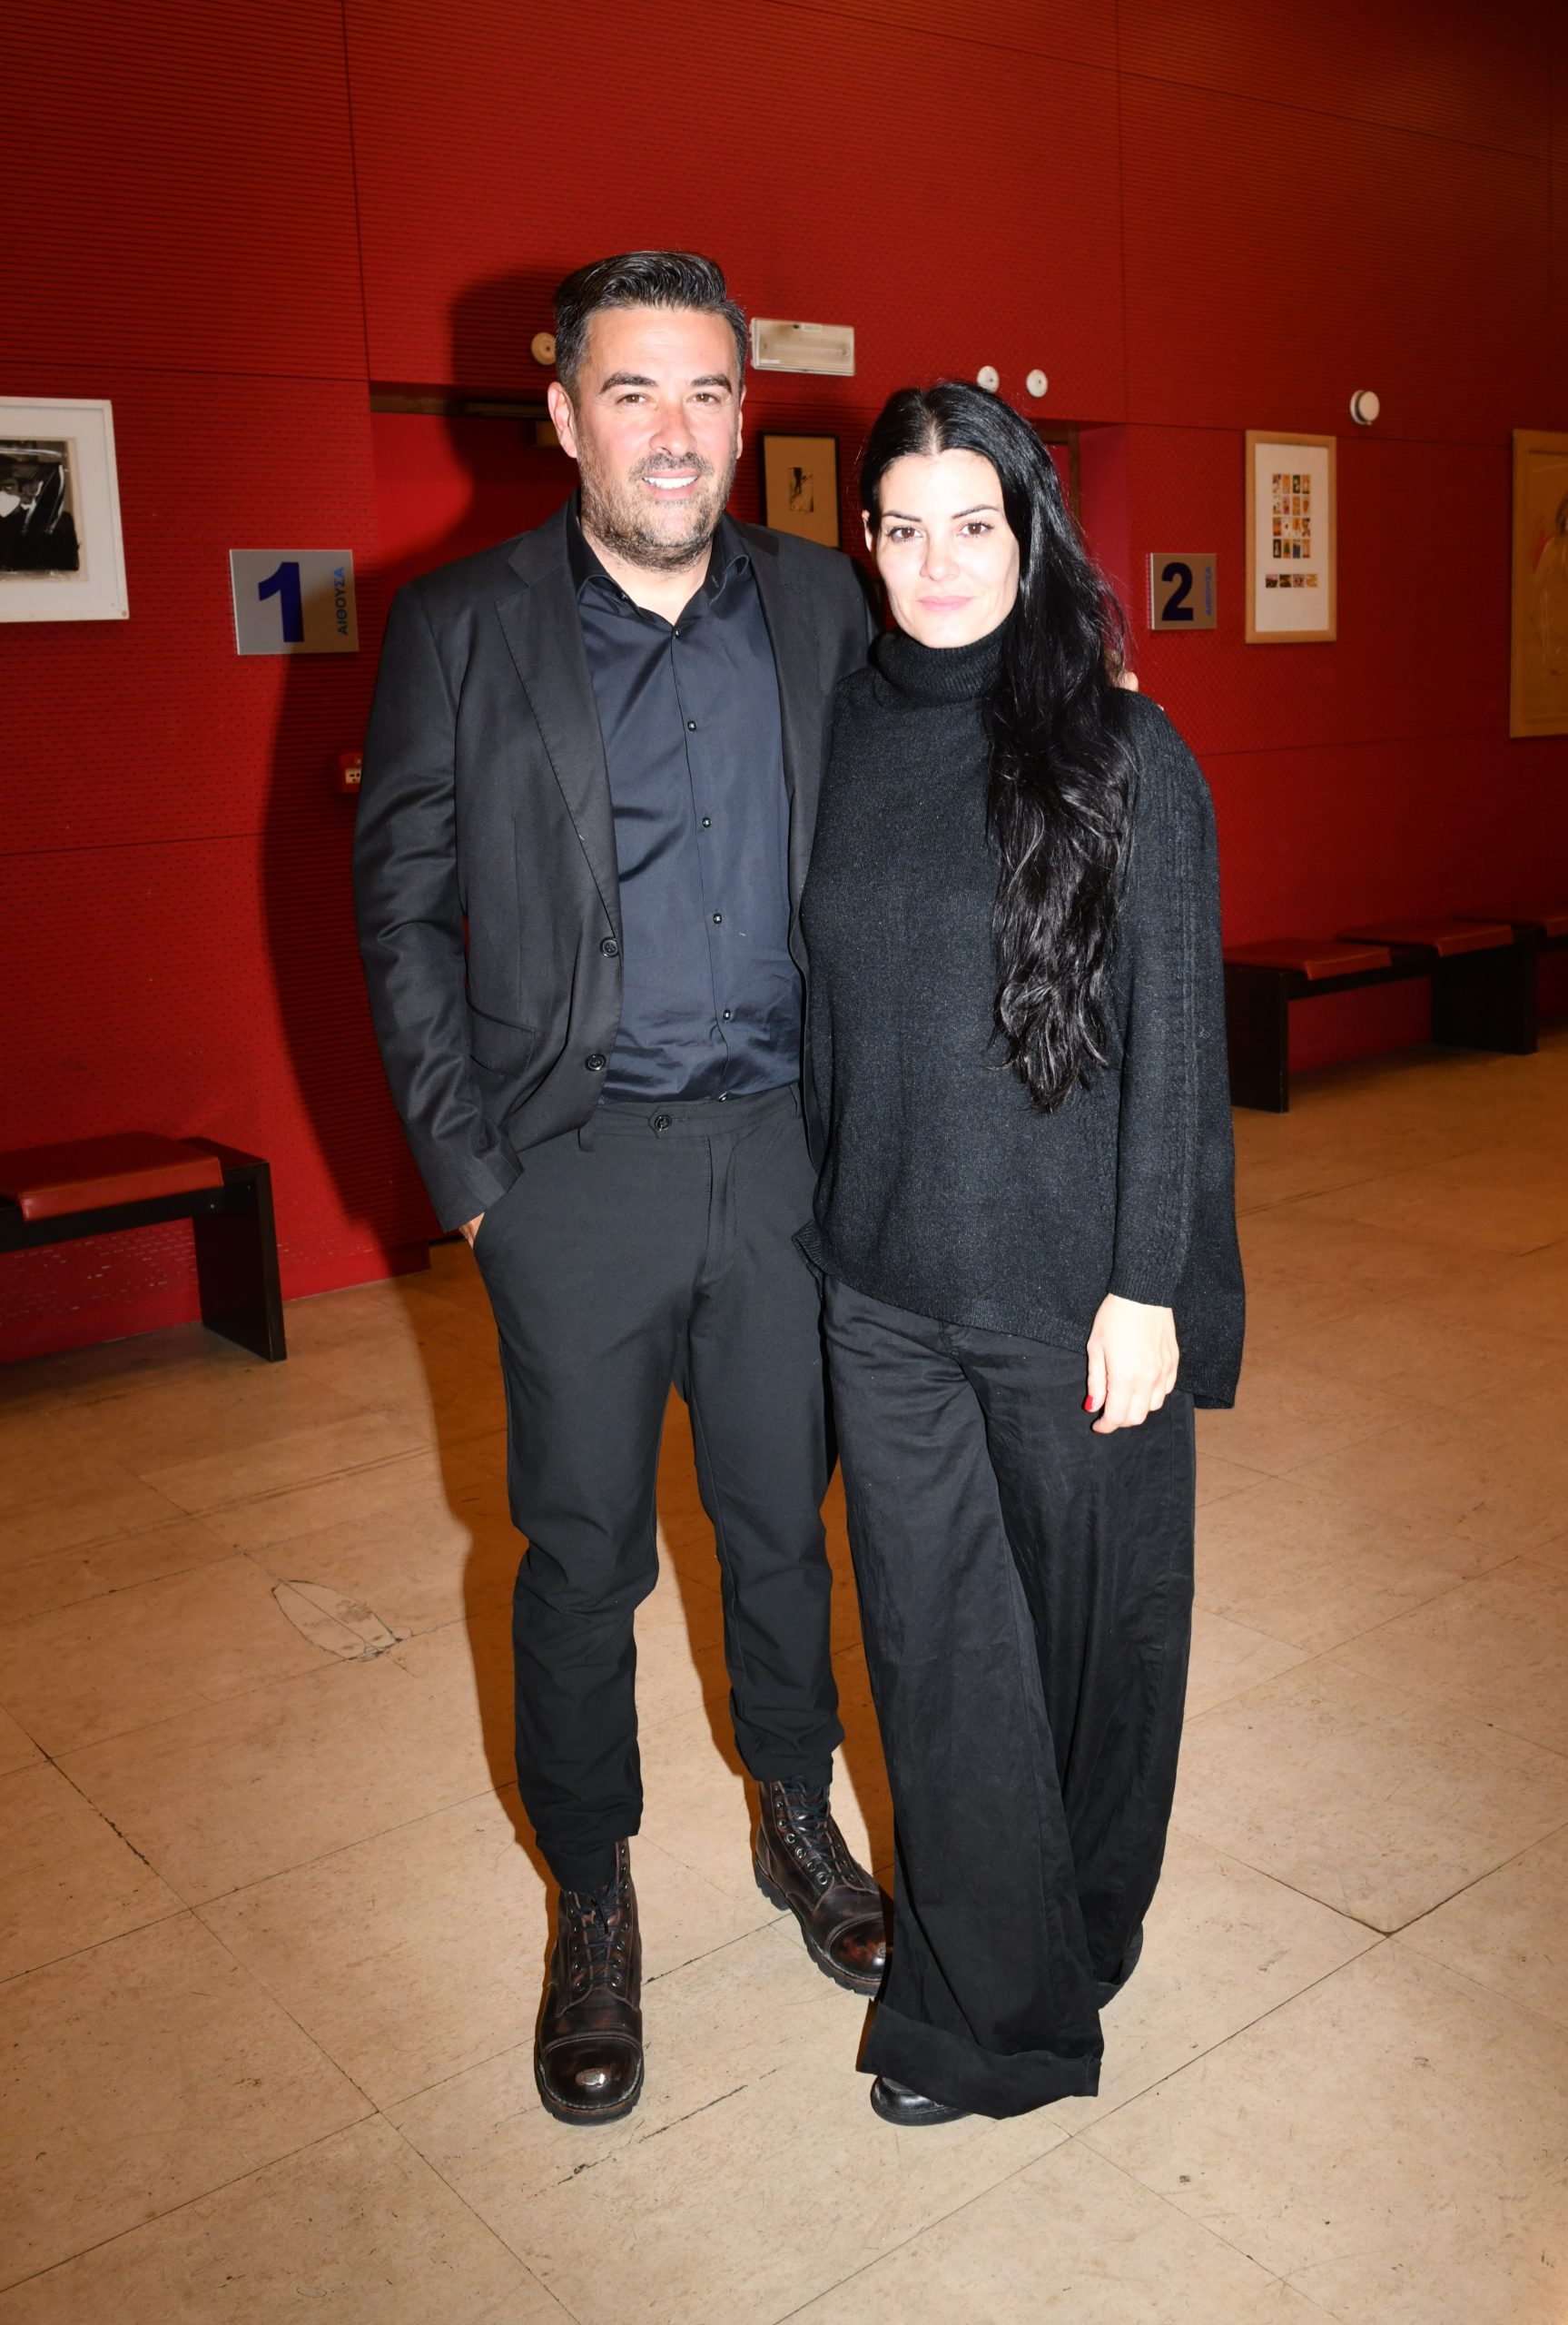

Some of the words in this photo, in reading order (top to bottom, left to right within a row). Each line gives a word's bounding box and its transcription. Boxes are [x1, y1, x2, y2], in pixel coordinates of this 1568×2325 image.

[258, 561, 304, 643] 1
[334, 567, 348, 636] ΑΙΘΟΥΣΑ
[1161, 561, 1193, 621] 2
